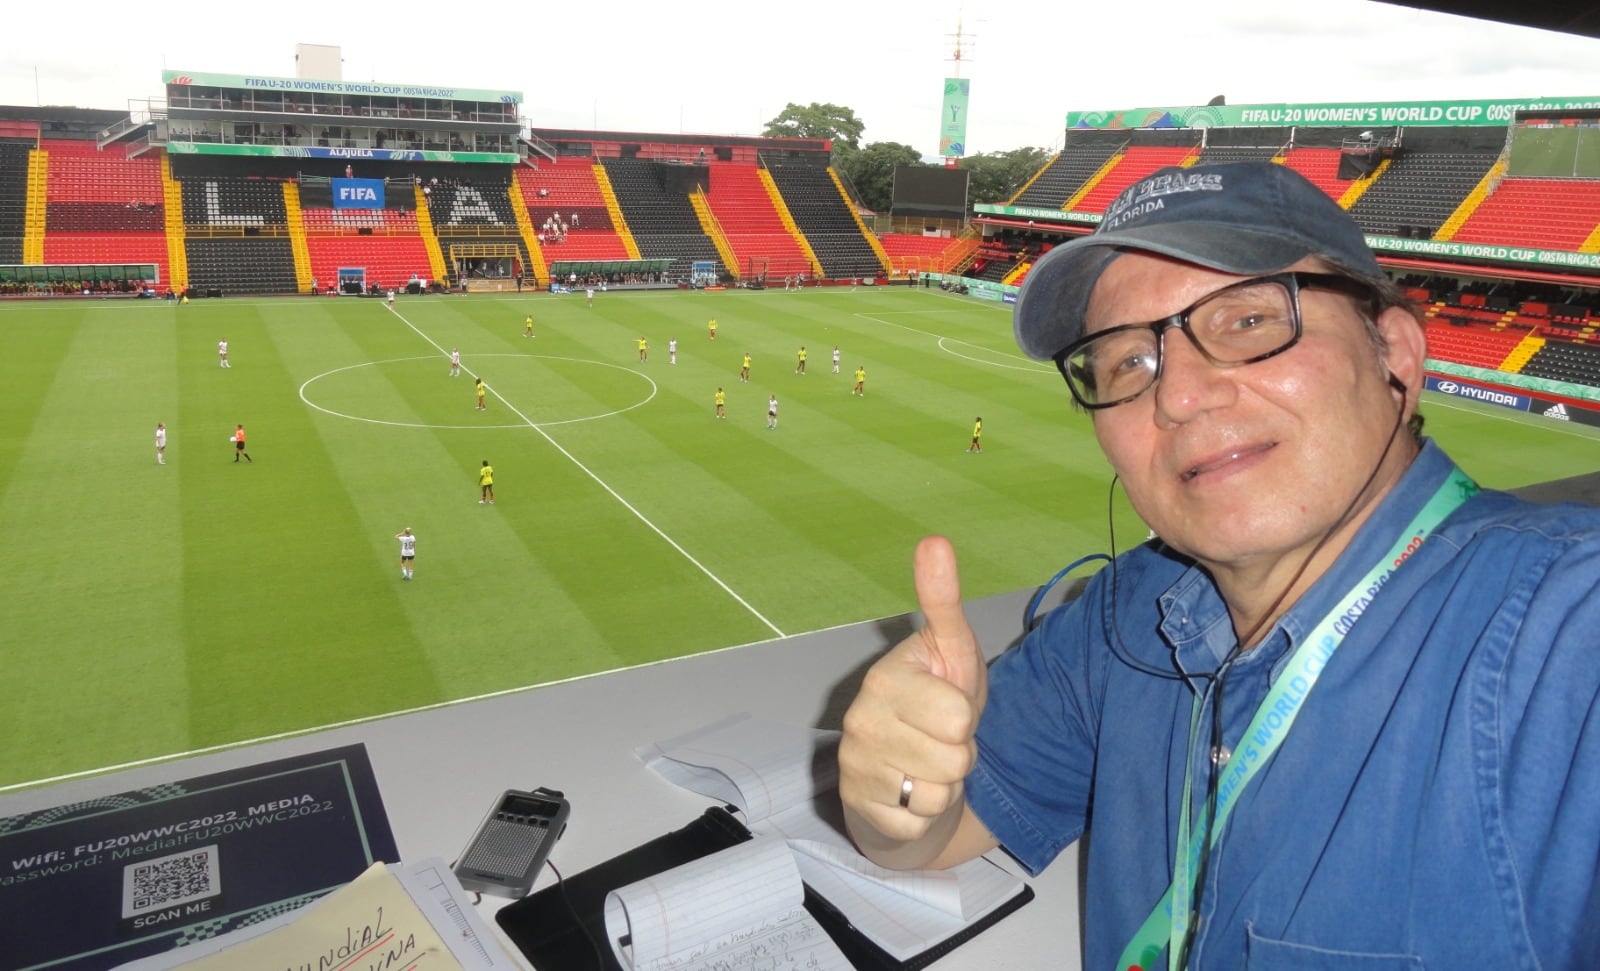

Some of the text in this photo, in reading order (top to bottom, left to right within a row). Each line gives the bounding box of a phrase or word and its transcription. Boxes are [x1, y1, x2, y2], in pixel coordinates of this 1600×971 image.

[245, 78, 267, 88] FIFA
[268, 80, 292, 89] U-20
[293, 81, 343, 91] WOMEN'S
[344, 84, 380, 94] WORLD
[382, 86, 401, 95] CUP
[1241, 110, 1270, 123] FIFA
[1271, 109, 1301, 122] U-20
[1304, 107, 1378, 122] WOMEN'S
[1381, 106, 1443, 121] WORLD
[1445, 105, 1483, 121] CUP
[329, 148, 374, 158] ALAJUELA
[339, 187, 377, 201] FIFA
[1014, 207, 1027, 216] FIFA
[1040, 209, 1067, 220] WOMEN'S
[1067, 212, 1089, 222] WORLD
[1090, 214, 1103, 222] CUP
[1107, 198, 1165, 231] FLORIDA
[1378, 238, 1403, 250] U-20
[1404, 240, 1459, 255] WOMEN'S
[1462, 244, 1507, 259] WORLD
[1509, 249, 1536, 261] CUP
[1538, 250, 1566, 264] COSTA
[1460, 385, 1518, 407] HYUNDAI
[1543, 410, 1570, 421] adidas
[1251, 673, 1310, 748] WORLD
[1303, 634, 1336, 680] CUP
[12, 793, 315, 871] Wifi: FU20WWC2022_MEDIA
[0, 800, 334, 887] assword: Media!FU20WWC2022
[133, 901, 212, 929] SCAN ME
